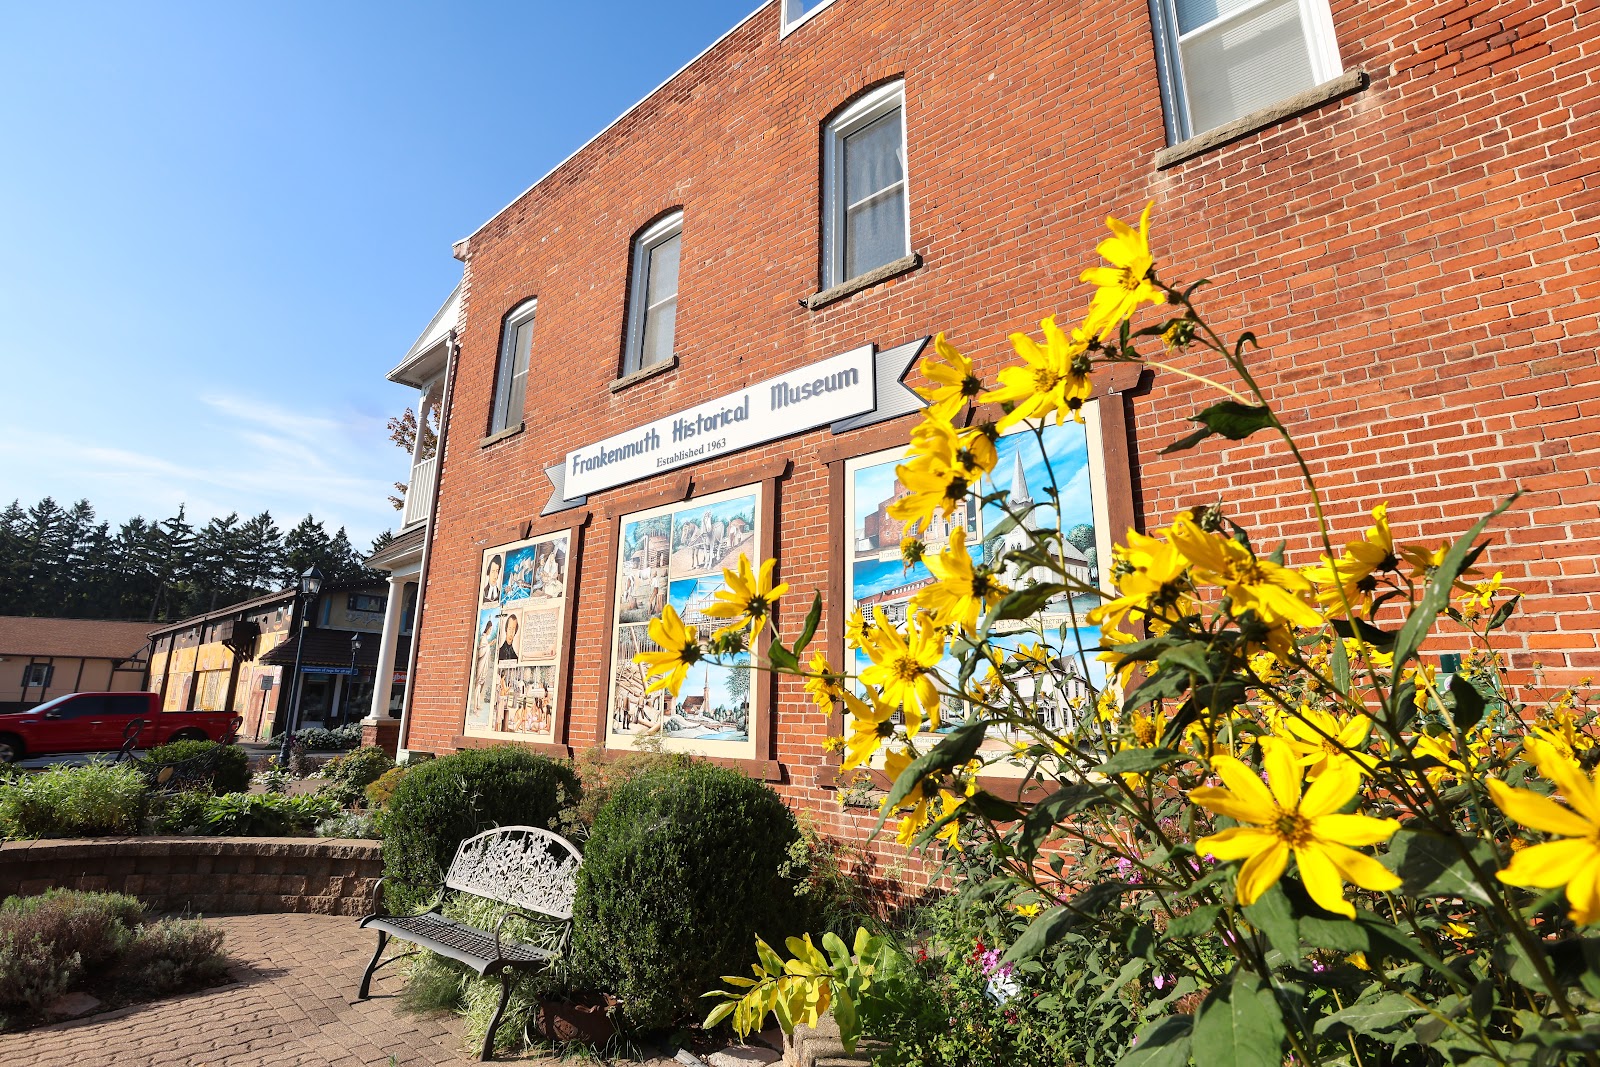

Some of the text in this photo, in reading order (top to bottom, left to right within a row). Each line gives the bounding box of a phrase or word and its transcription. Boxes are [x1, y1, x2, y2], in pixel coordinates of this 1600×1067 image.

[573, 367, 859, 476] Frankenmuth Historical Museum
[656, 438, 726, 468] Established 1963
